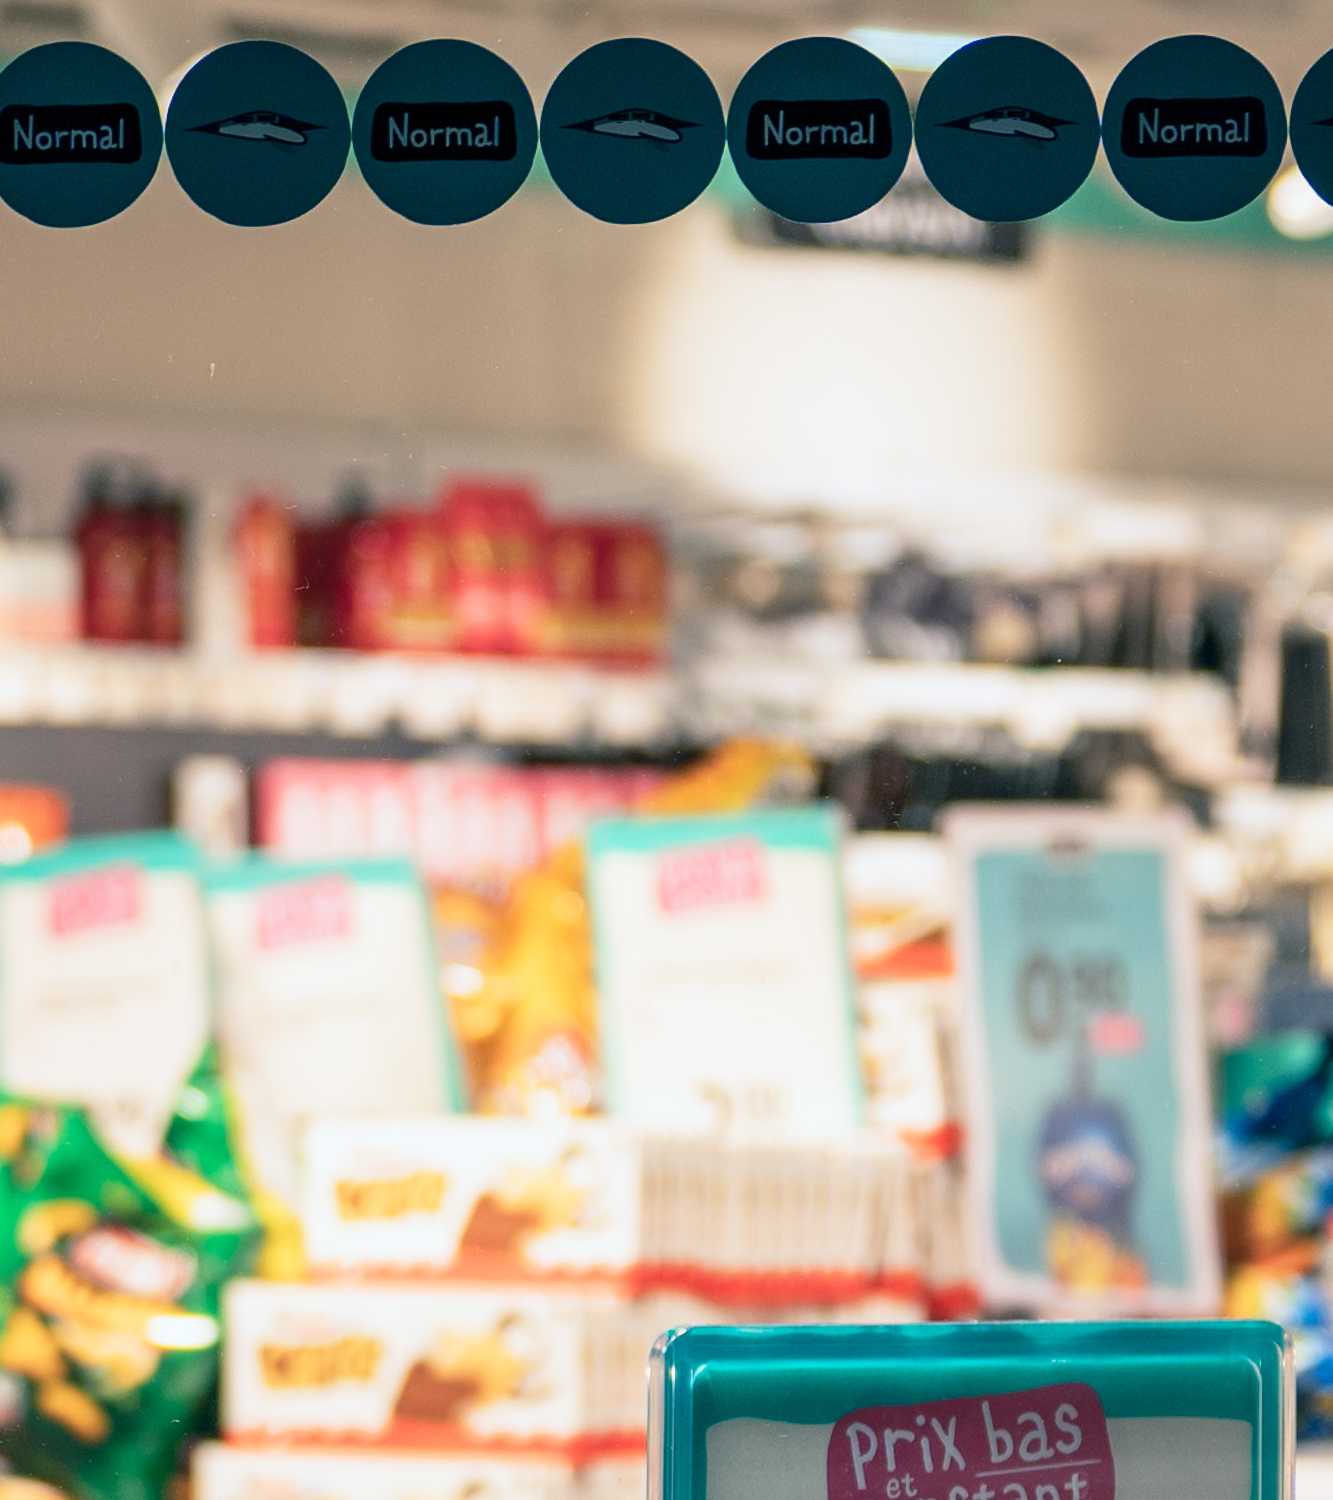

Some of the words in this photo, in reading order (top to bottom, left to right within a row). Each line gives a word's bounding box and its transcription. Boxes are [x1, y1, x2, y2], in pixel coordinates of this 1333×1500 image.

[13, 114, 124, 151] Normal
[388, 112, 499, 149] Normal
[764, 109, 875, 146] Normal
[1139, 108, 1249, 145] Normal
[982, 1400, 1083, 1463] bas
[886, 1474, 918, 1499] et
